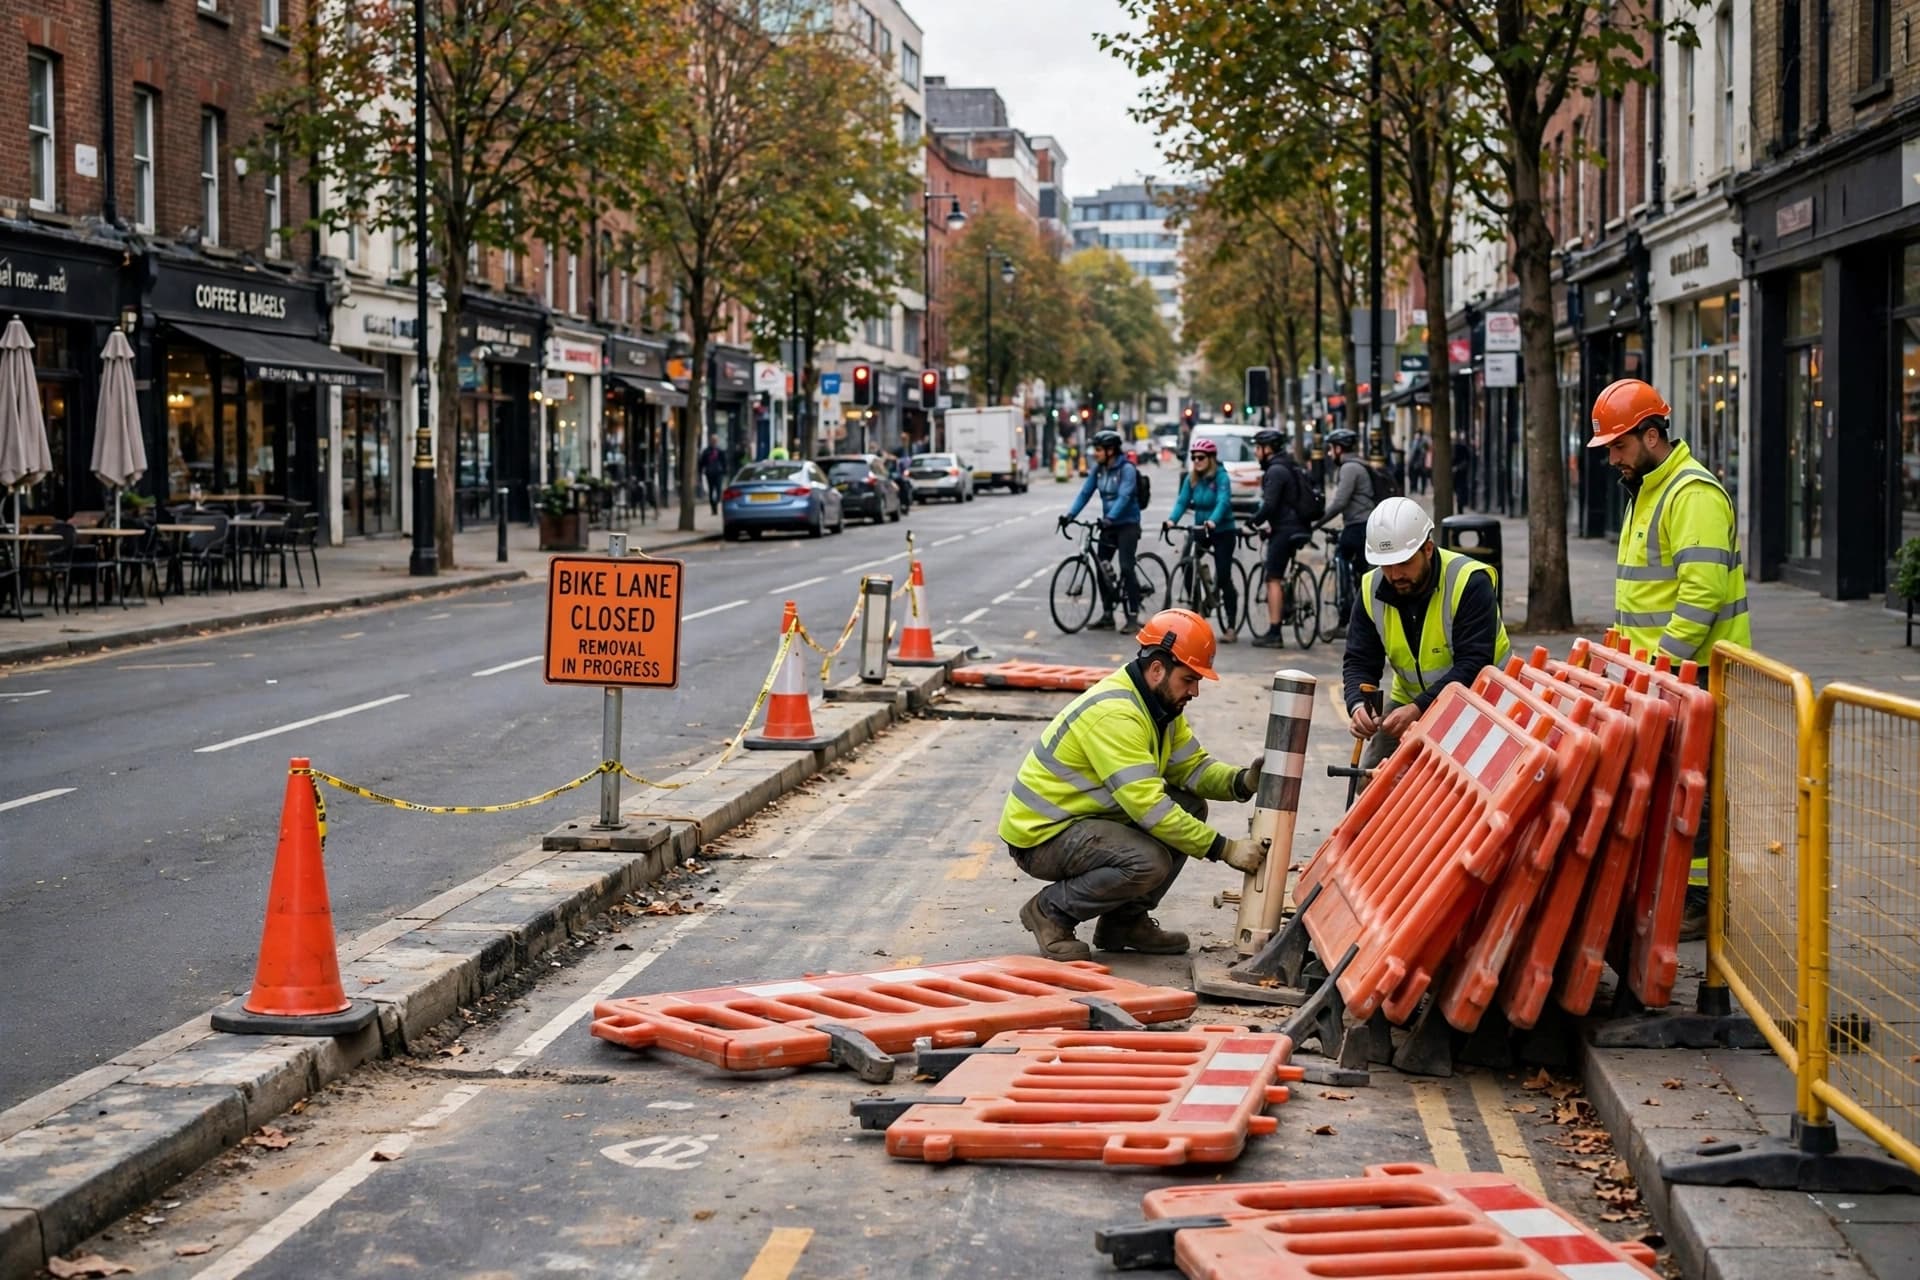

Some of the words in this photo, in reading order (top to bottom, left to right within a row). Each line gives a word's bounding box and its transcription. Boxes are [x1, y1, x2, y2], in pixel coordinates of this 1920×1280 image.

[196, 284, 237, 312] COFFEE
[239, 291, 247, 313] &
[249, 292, 286, 319] BAGELS
[559, 570, 607, 596] BIKE
[616, 572, 672, 598] LANE
[571, 605, 655, 633] CLOSED
[578, 639, 646, 657] REMOVAL
[562, 658, 576, 674] IN
[583, 659, 660, 678] PROGRESS
